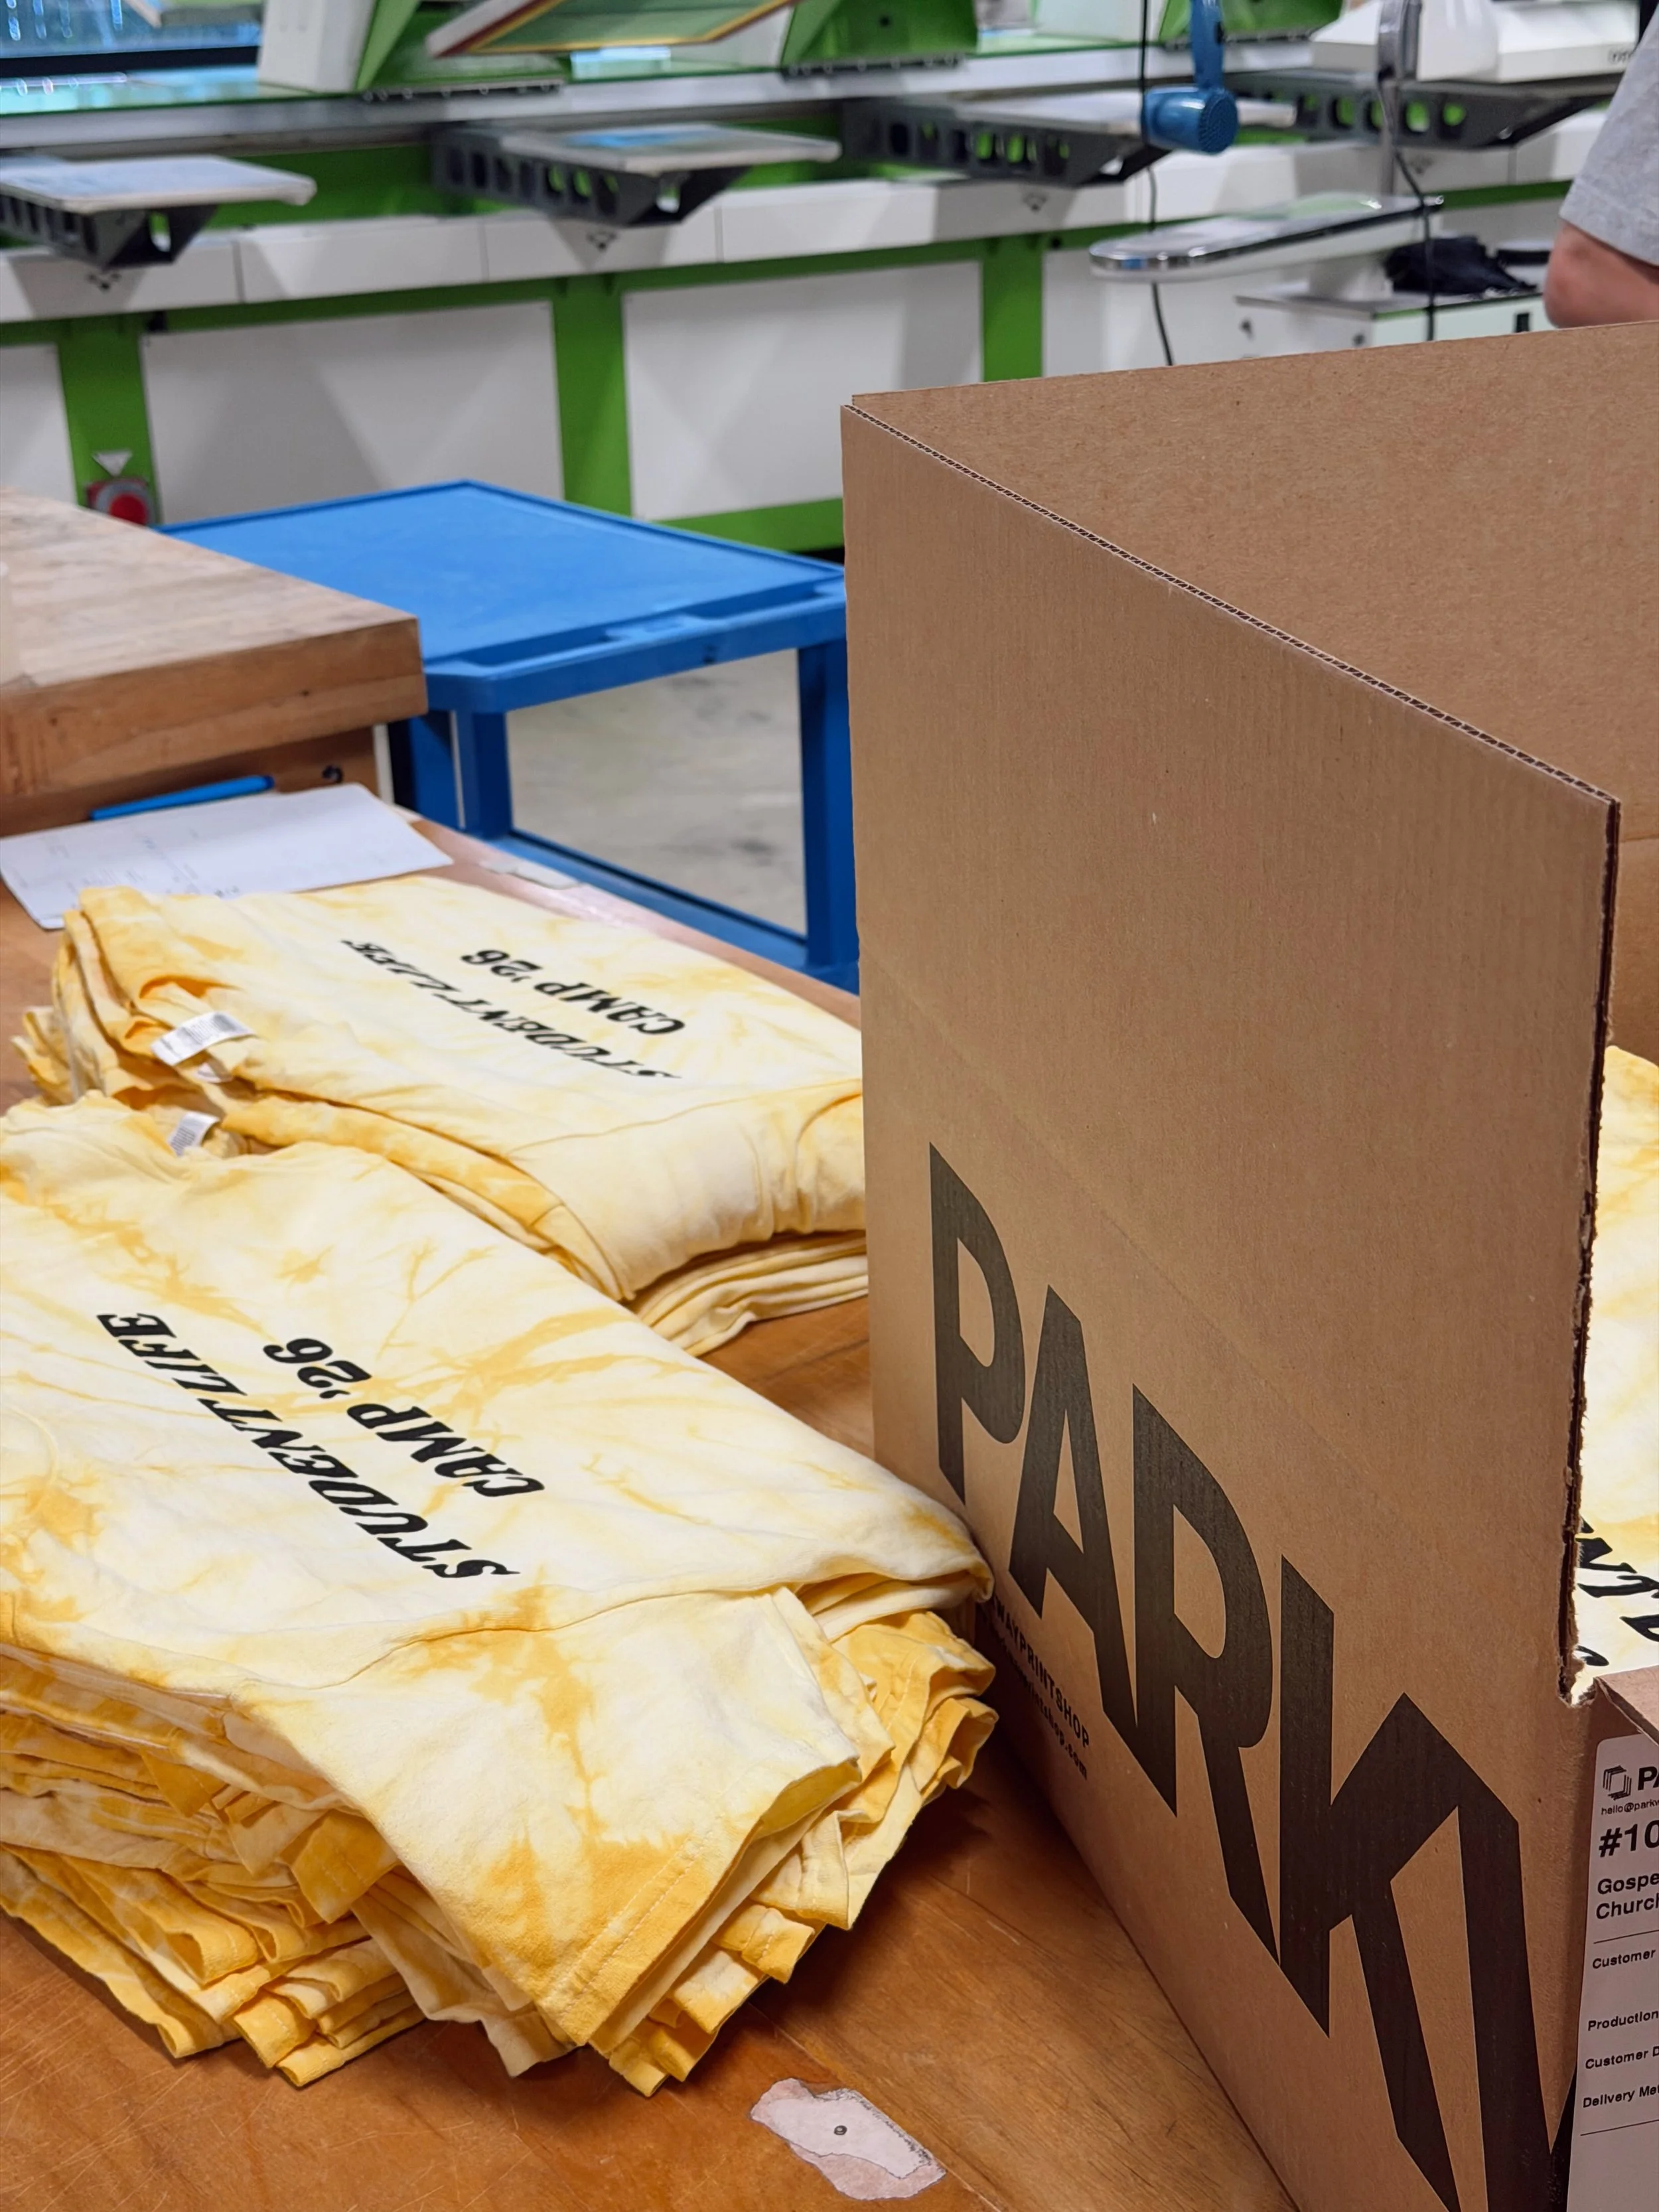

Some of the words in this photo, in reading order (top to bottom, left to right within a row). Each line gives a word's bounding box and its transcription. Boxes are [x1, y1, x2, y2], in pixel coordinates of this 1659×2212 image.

[341, 940, 461, 992] LIFE
[461, 949, 543, 982] '26
[534, 982, 685, 1035] CAMP
[432, 994, 682, 1078] STUDENT
[97, 1313, 247, 1396] LIFE
[263, 1337, 372, 1399] '26
[347, 1403, 545, 1497] CAMP
[197, 1398, 520, 1578] STUDENT
[993, 1592, 1090, 1748] WAYPRINTSHOP
[1598, 1820, 1659, 1858] #10
[1597, 1872, 1659, 1895] Gospe
[1592, 1948, 1656, 1970] Customer
[1587, 2010, 1659, 2031] Production
[1585, 2049, 1649, 2070] Customer
[1582, 2088, 1635, 2109] Delivery
